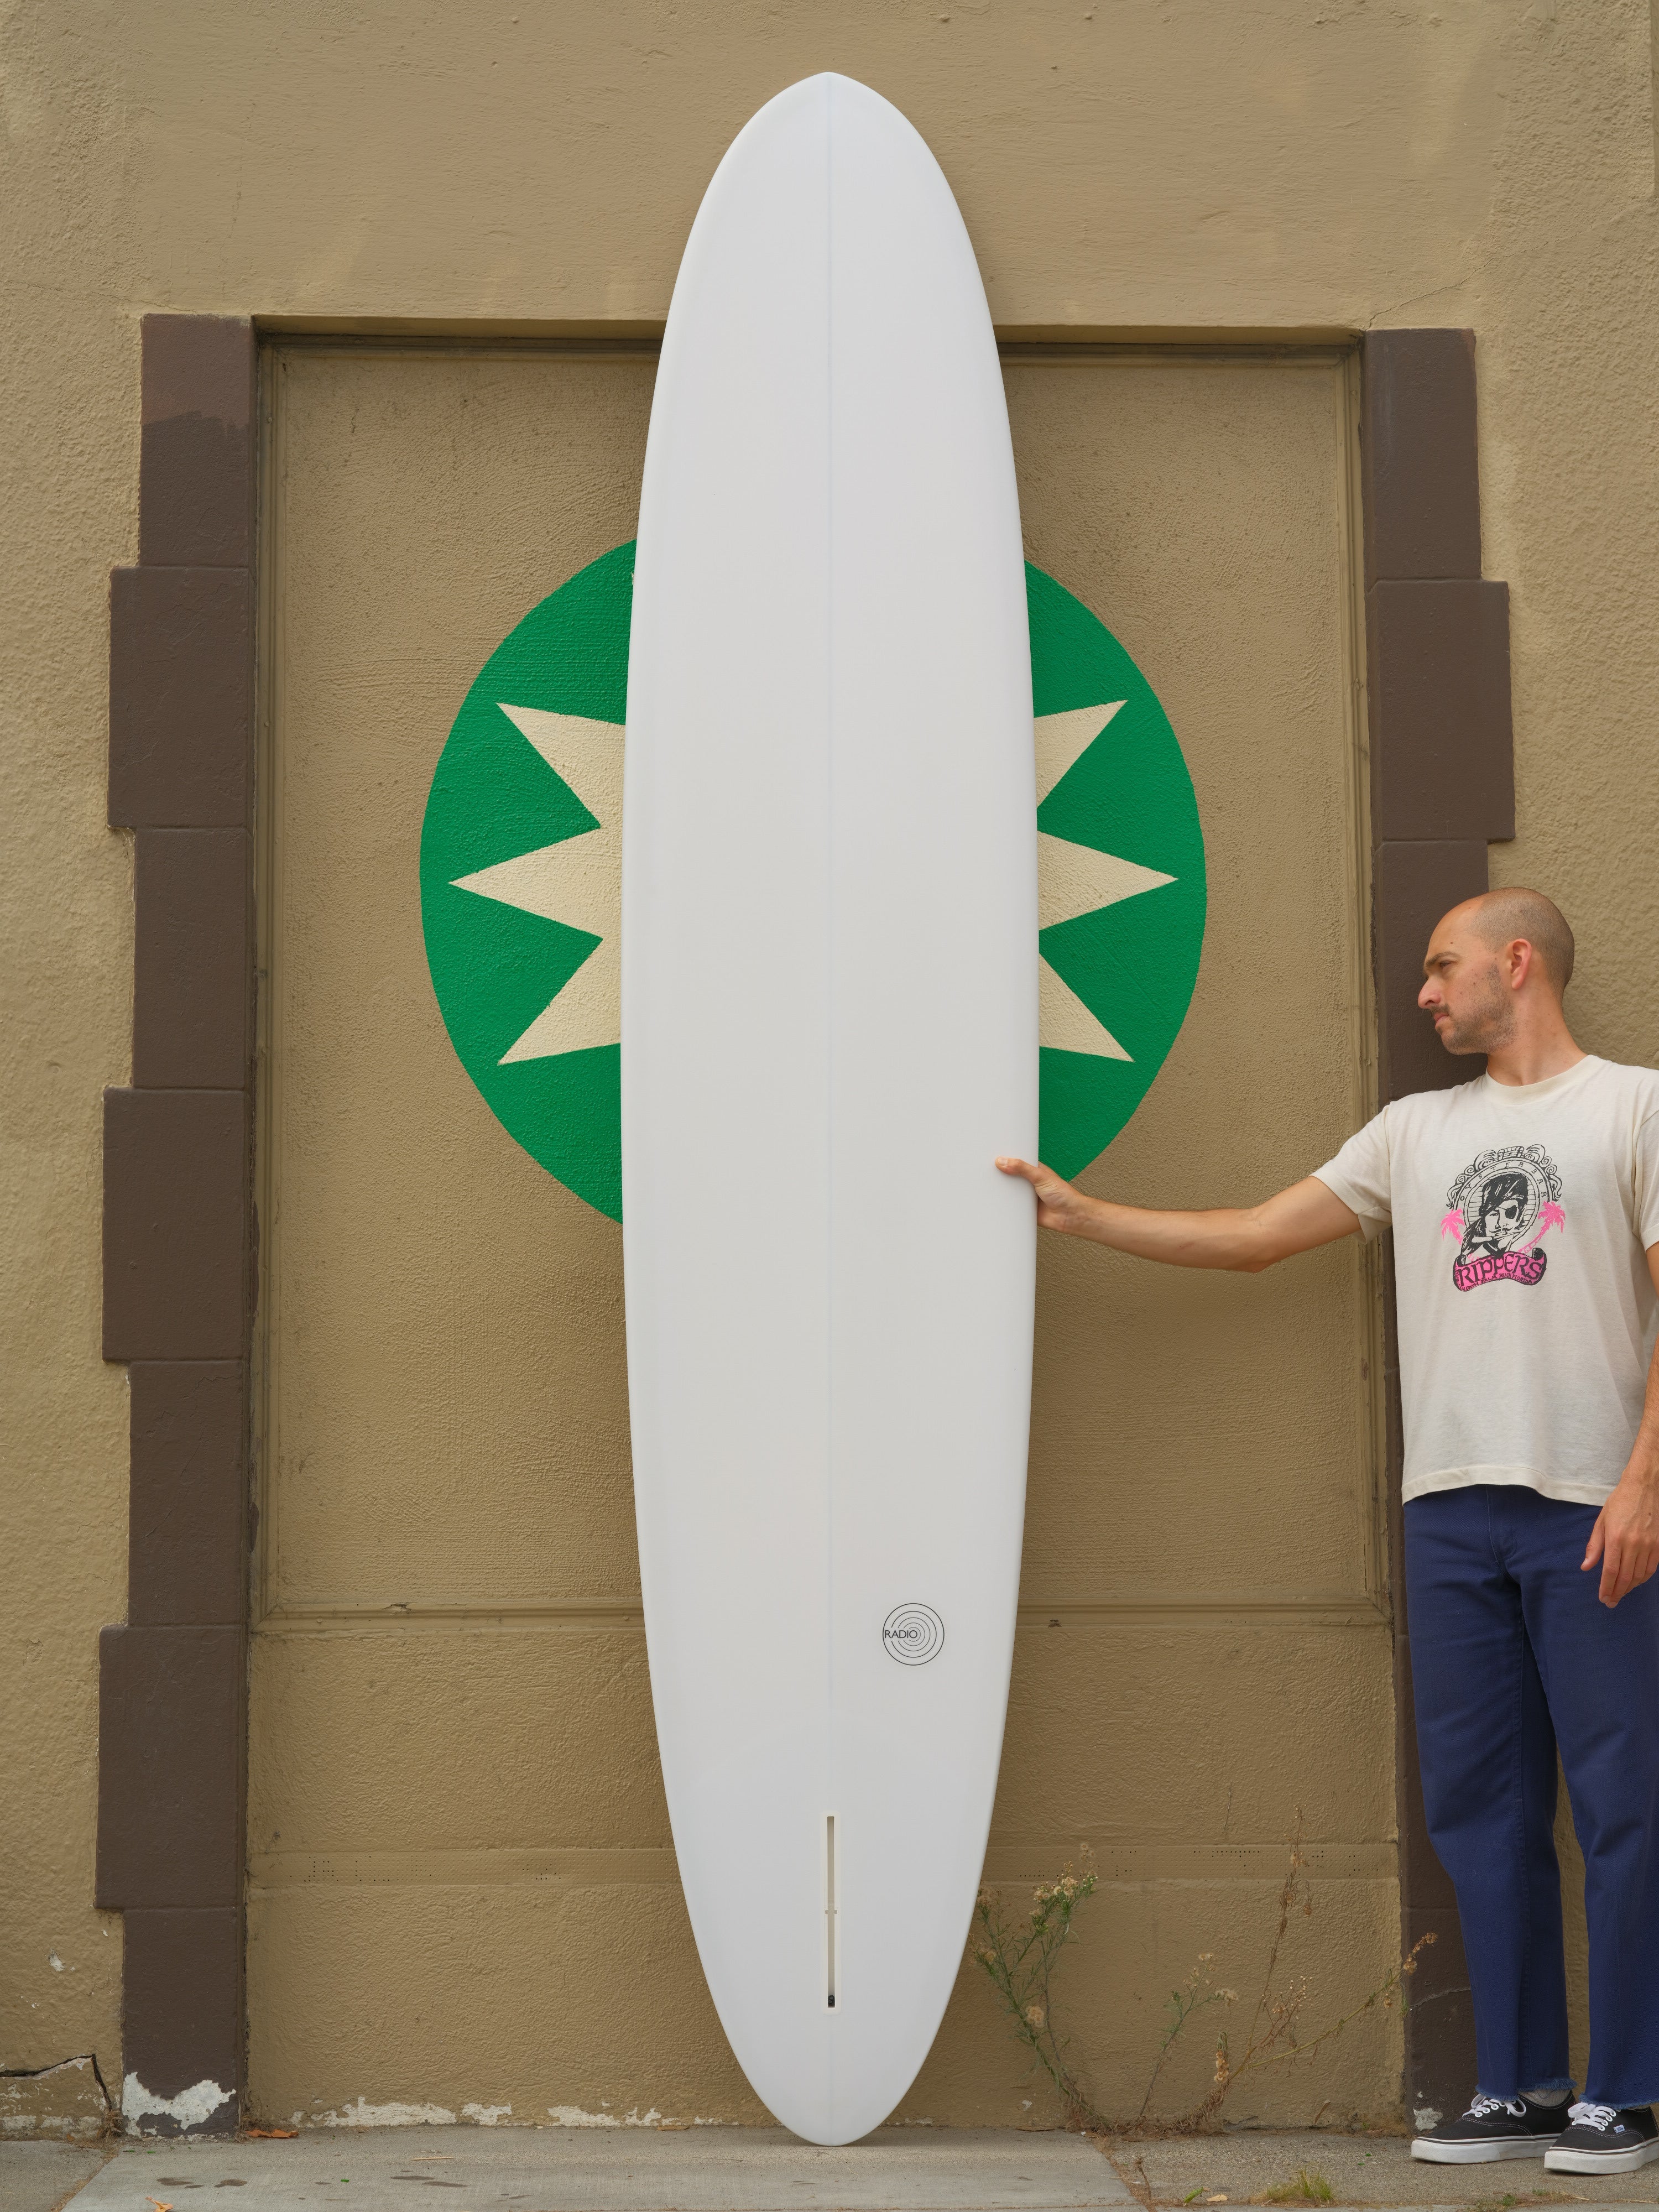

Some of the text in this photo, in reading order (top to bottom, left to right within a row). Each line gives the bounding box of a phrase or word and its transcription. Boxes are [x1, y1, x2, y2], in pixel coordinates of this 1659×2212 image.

[1460, 1162, 1547, 1201] OYSTER BAR
[1455, 1254, 1543, 1287] RIPPERS
[1462, 1282, 1478, 1291] NORTH
[1481, 1275, 1497, 1284] PALM
